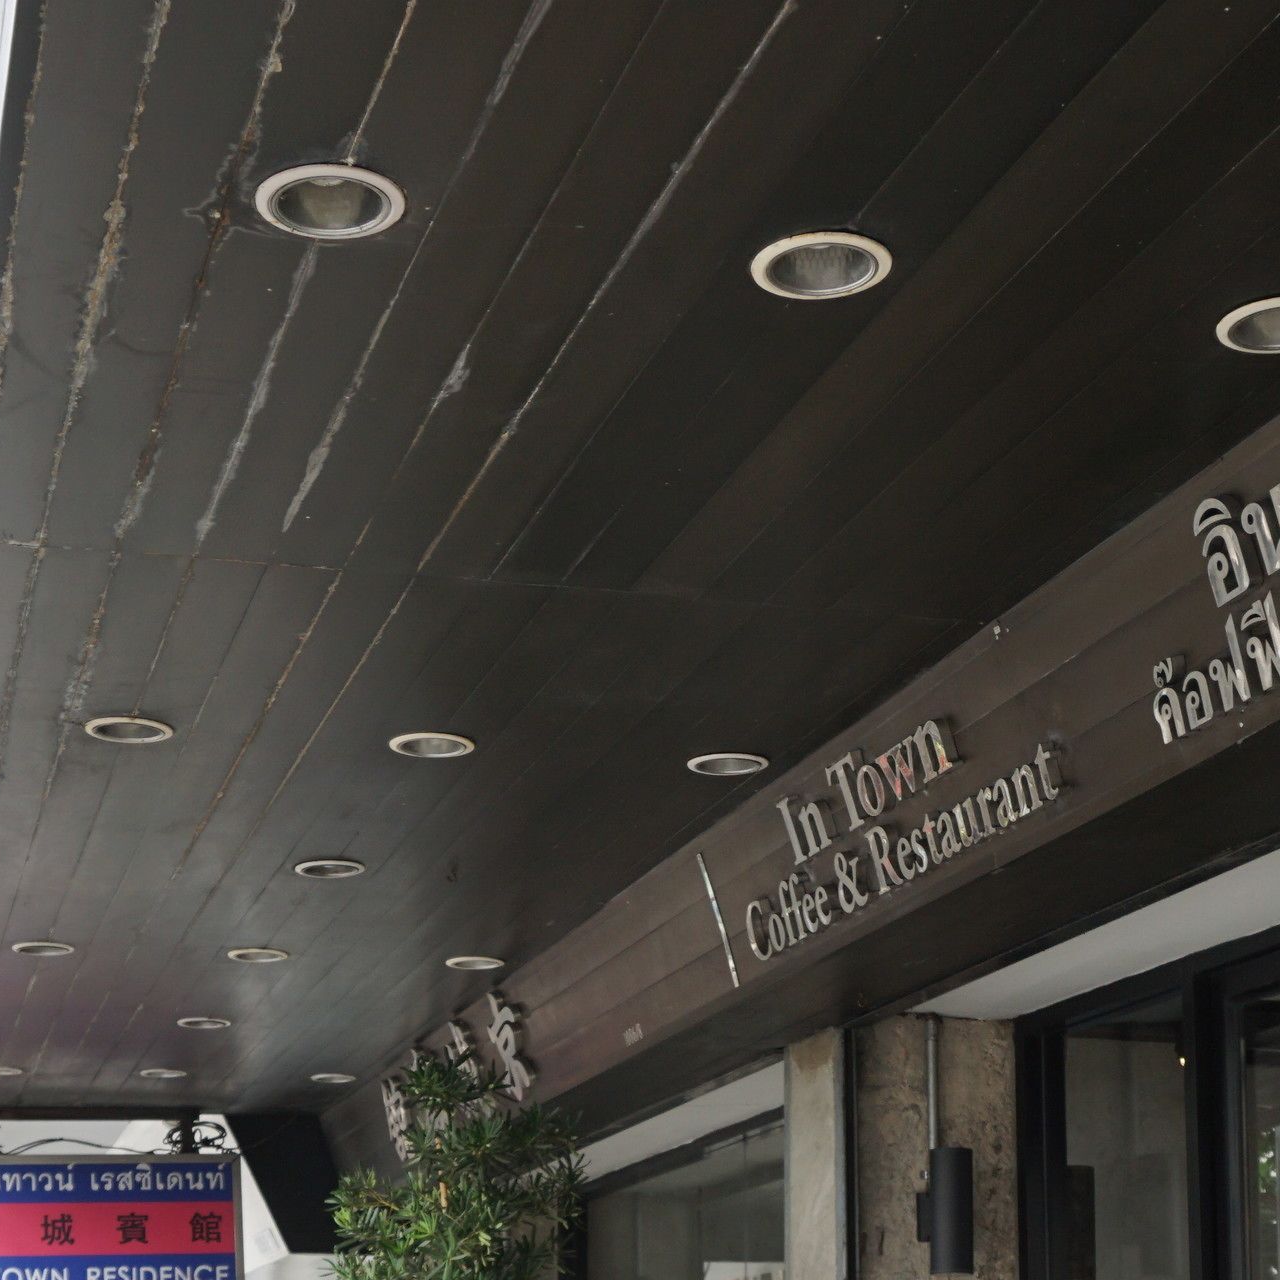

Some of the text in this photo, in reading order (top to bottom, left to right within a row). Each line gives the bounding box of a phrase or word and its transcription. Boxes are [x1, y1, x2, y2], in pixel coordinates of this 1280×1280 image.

[746, 743, 1060, 962] Coffee & Restaurant
[776, 718, 954, 866] In Town
